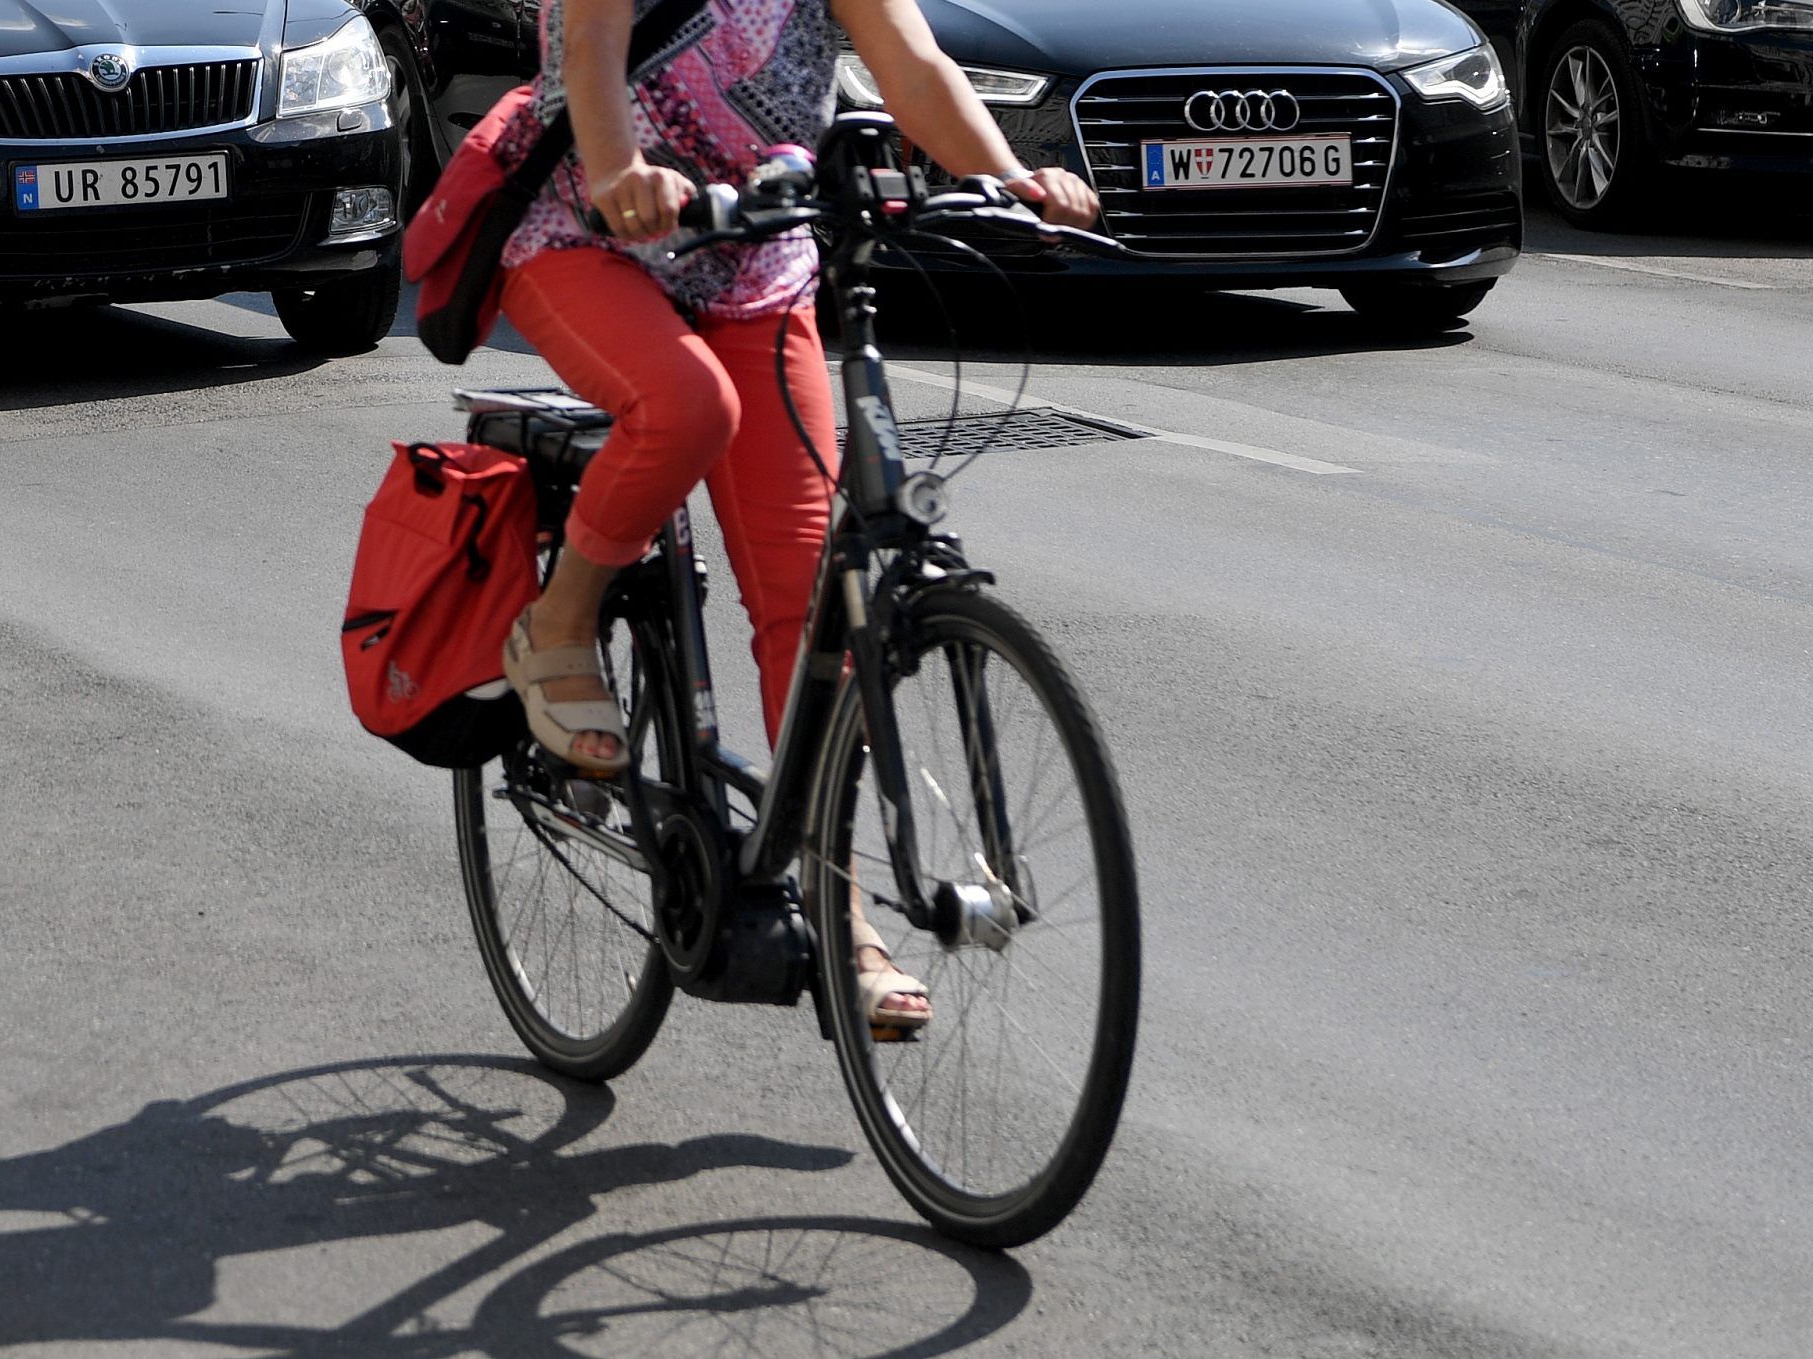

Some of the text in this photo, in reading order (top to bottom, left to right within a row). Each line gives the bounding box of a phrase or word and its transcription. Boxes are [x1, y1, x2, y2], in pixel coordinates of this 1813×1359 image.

[23, 161, 221, 204] N UR 85791
[1151, 171, 1160, 180] A
[1170, 148, 1191, 180] W
